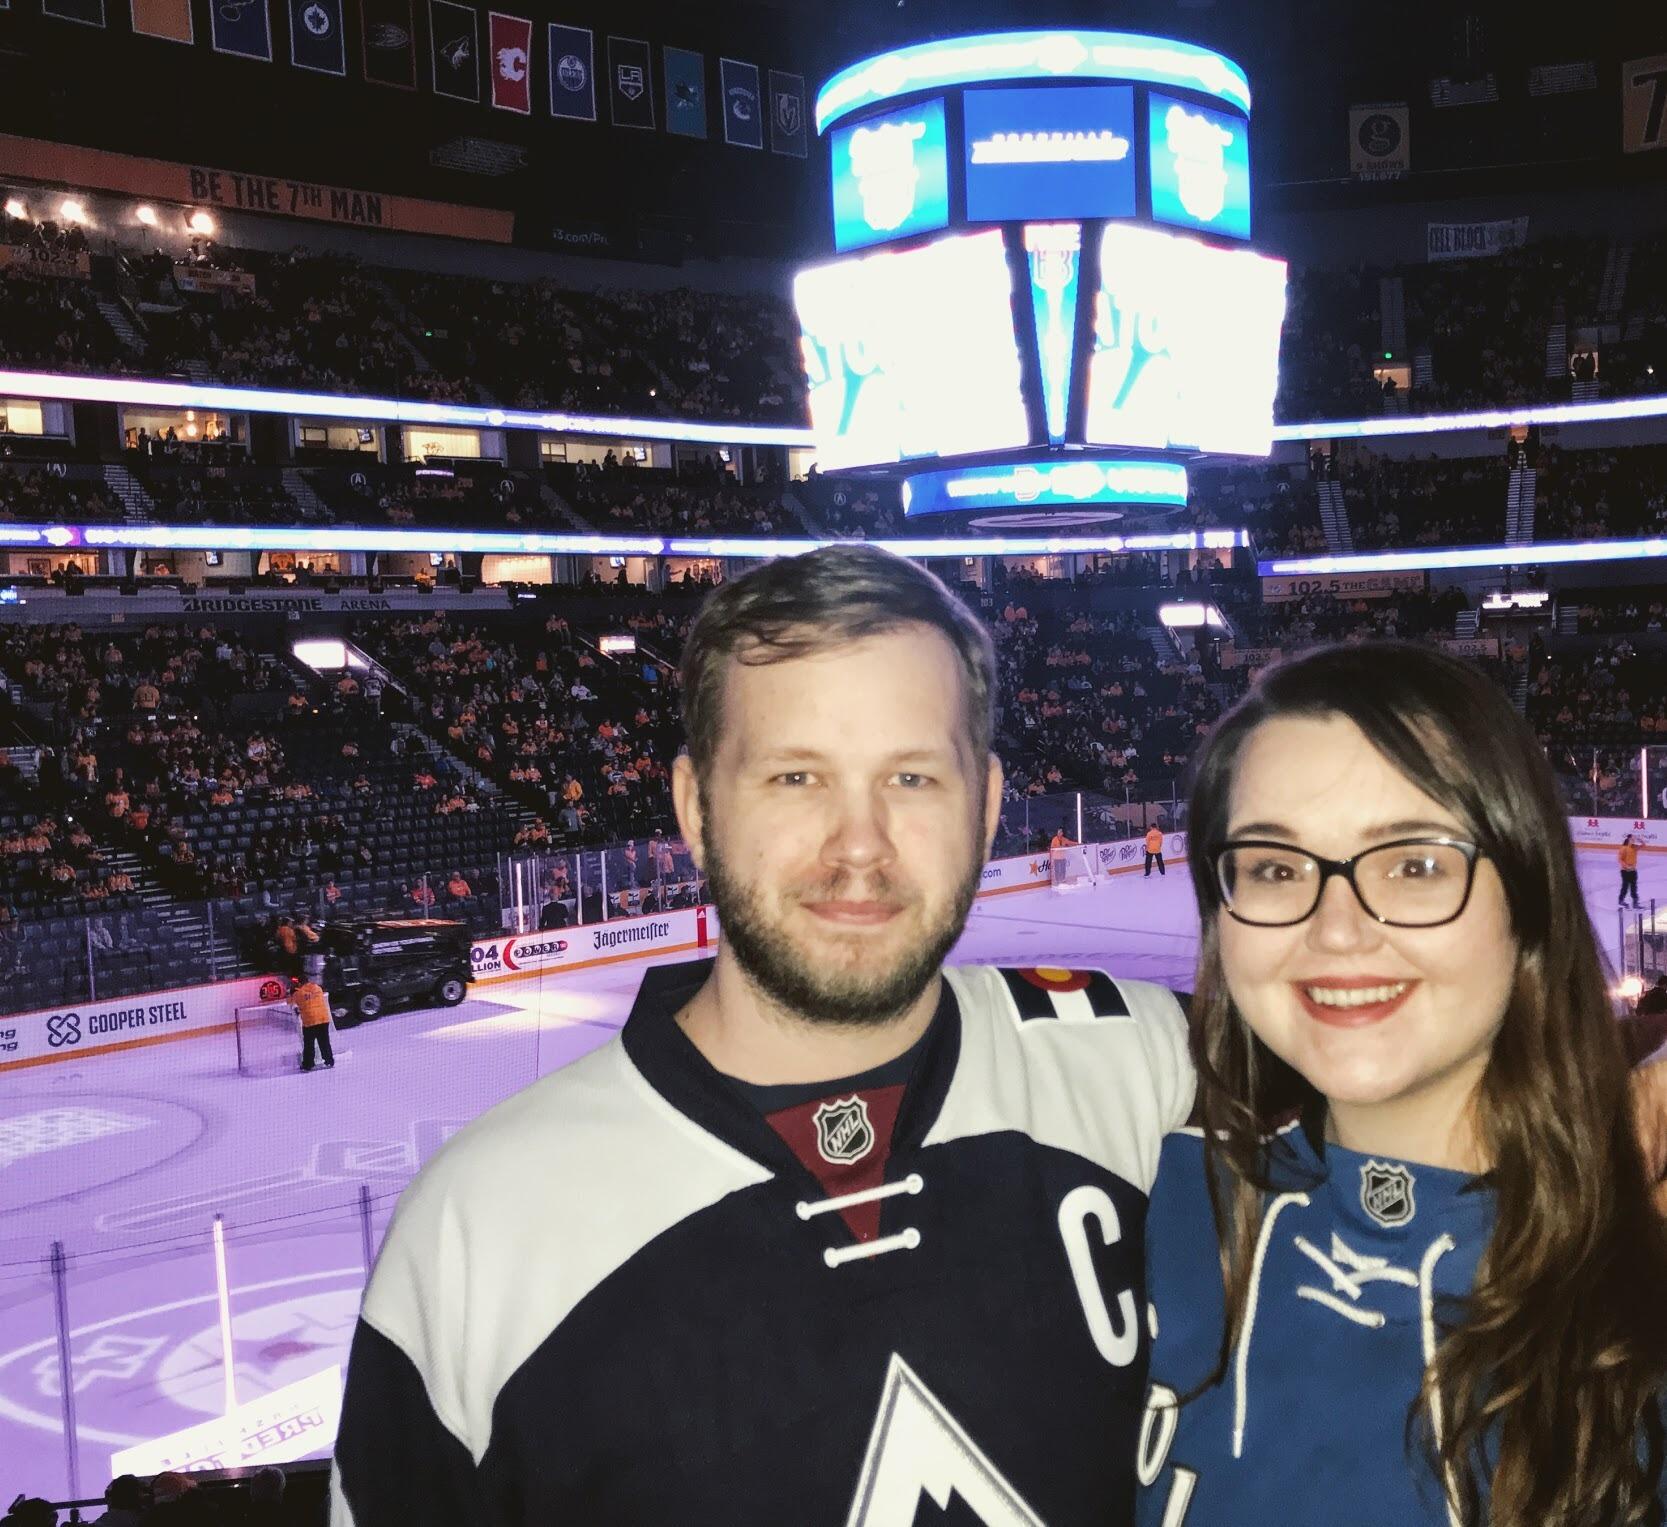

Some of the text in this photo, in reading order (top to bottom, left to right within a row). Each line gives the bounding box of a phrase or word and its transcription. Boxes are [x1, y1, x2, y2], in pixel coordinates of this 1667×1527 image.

[190, 168, 223, 201] BE
[231, 174, 280, 210] THE
[329, 189, 383, 225] MAN
[1288, 580, 1341, 596] 102.5
[1342, 581, 1366, 590] THE
[183, 598, 391, 612] BRIDGESTONE ARENA
[514, 942, 560, 959] POWER
[88, 1002, 187, 1035] COOPER STEEL
[829, 1114, 860, 1154] NHL
[1373, 1182, 1404, 1211] NHL
[1057, 1185, 1139, 1367] C
